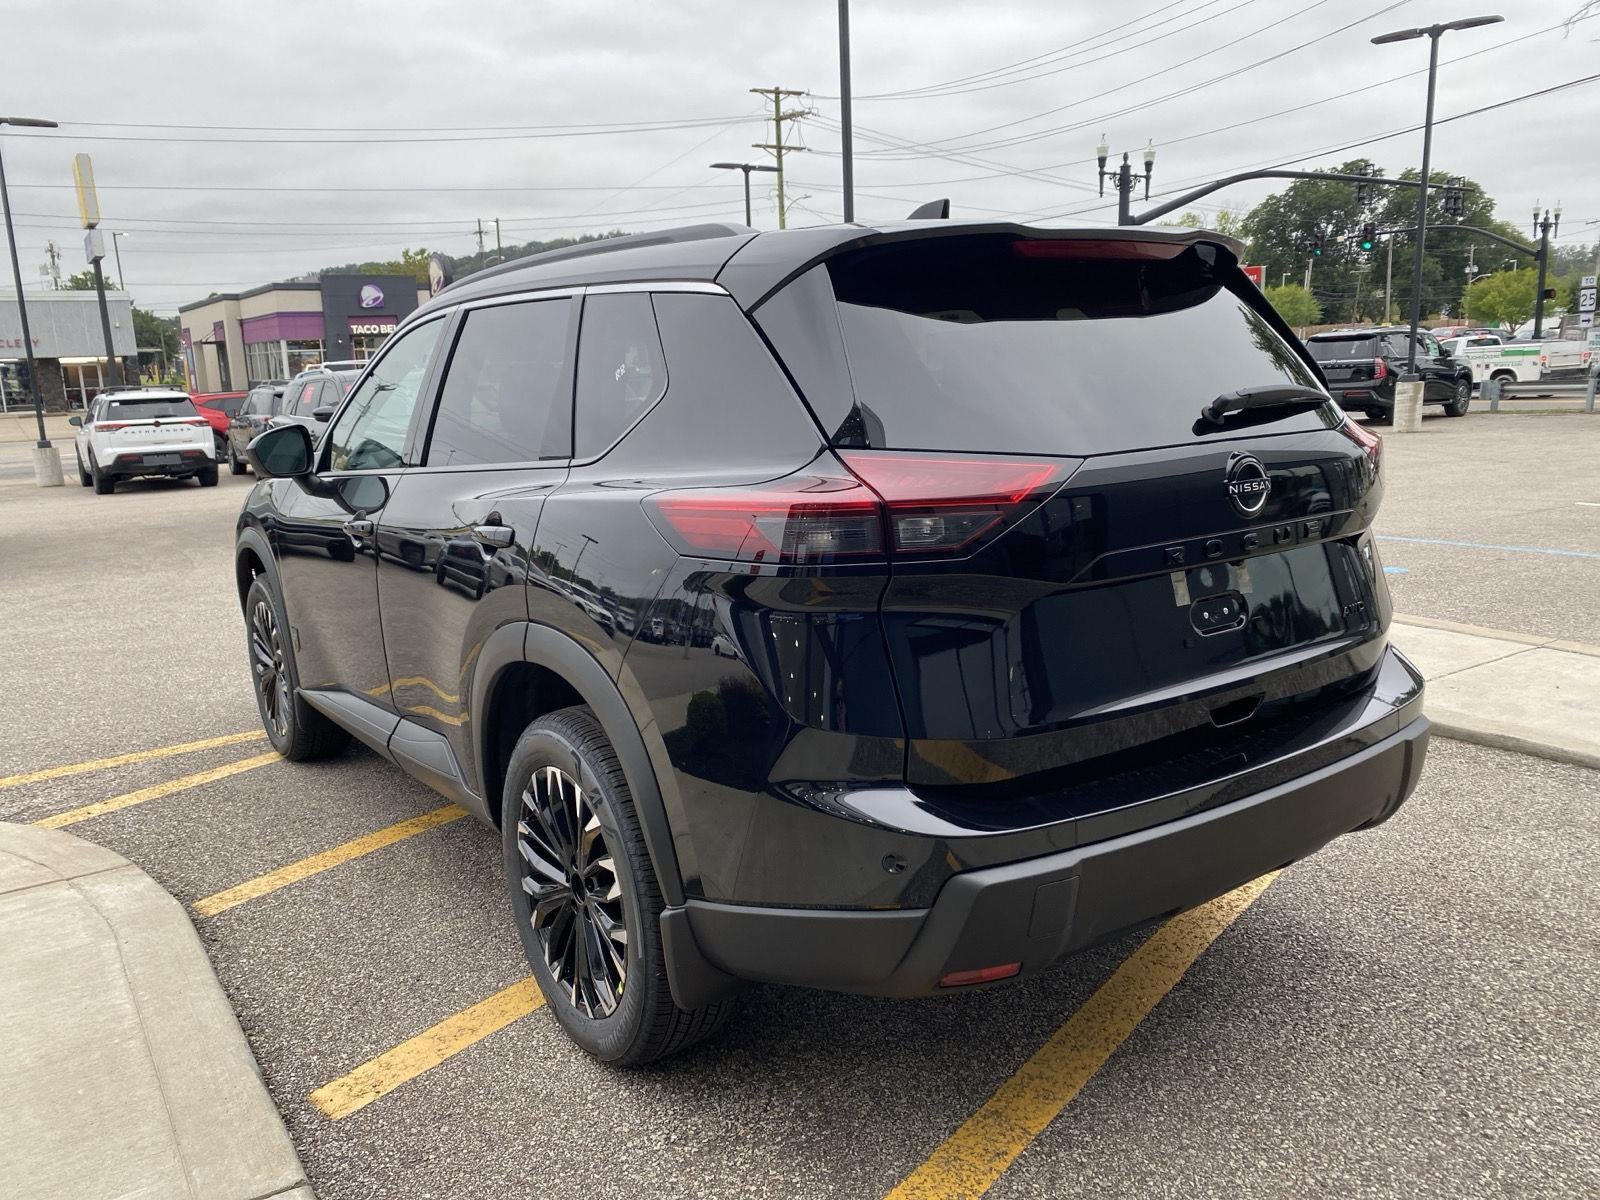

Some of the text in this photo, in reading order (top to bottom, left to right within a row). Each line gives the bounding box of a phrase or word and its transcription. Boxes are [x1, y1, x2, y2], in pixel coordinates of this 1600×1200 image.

[1581, 292, 1596, 307] 25
[350, 324, 379, 334] TACO
[1229, 480, 1271, 494] NISSAN
[1164, 520, 1321, 566] ROGUE
